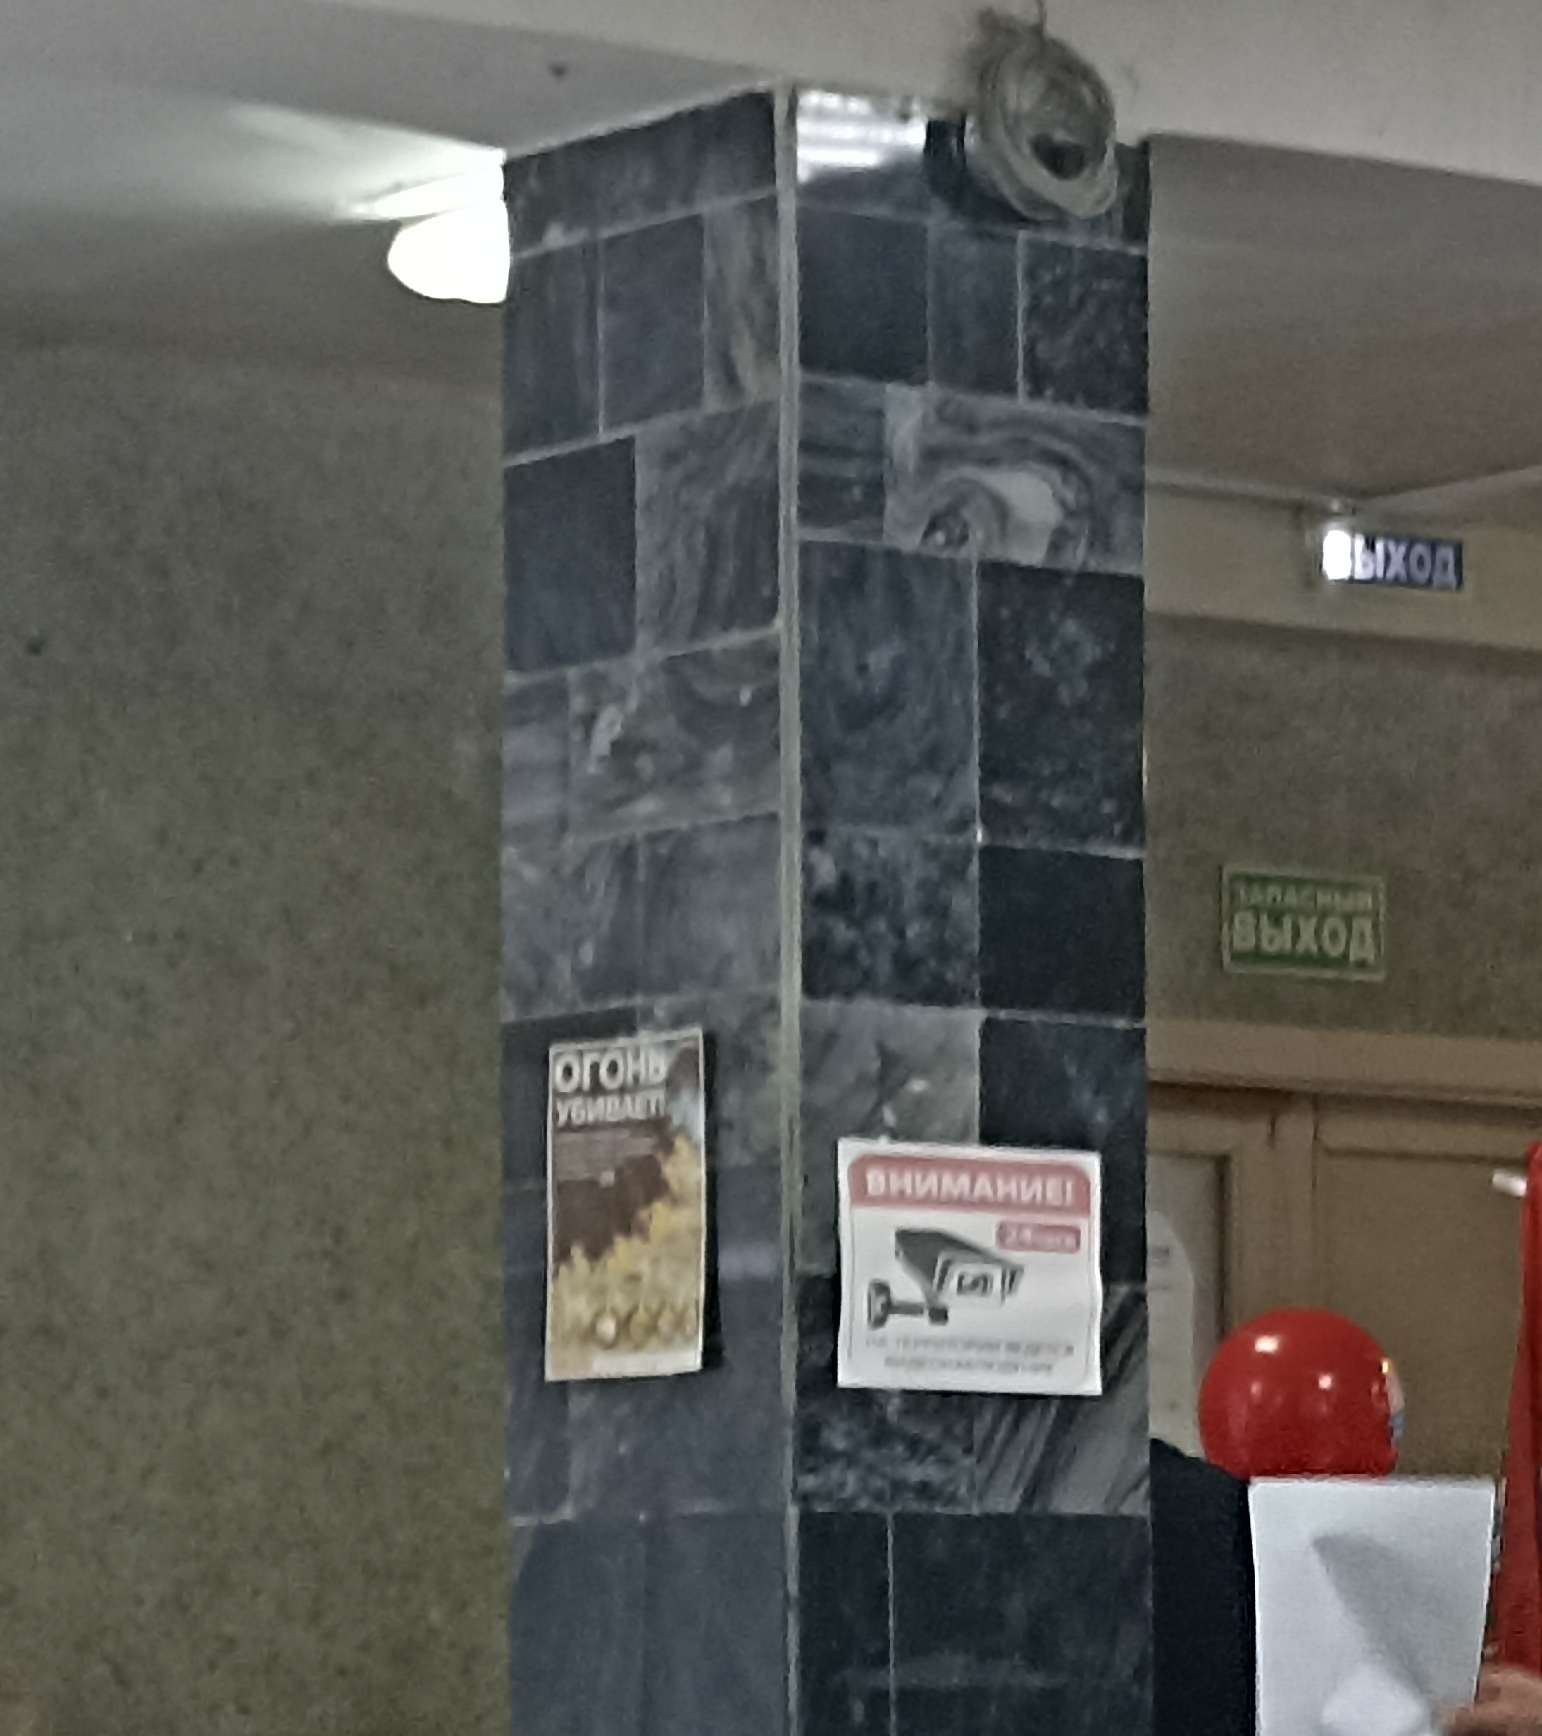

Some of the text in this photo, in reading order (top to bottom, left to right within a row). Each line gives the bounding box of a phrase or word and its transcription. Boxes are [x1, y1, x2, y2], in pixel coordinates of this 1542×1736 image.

[1323, 530, 1457, 591] ЫХОД
[1233, 911, 1375, 962] ВЫХОД
[555, 1046, 666, 1093] ОГОНЬ
